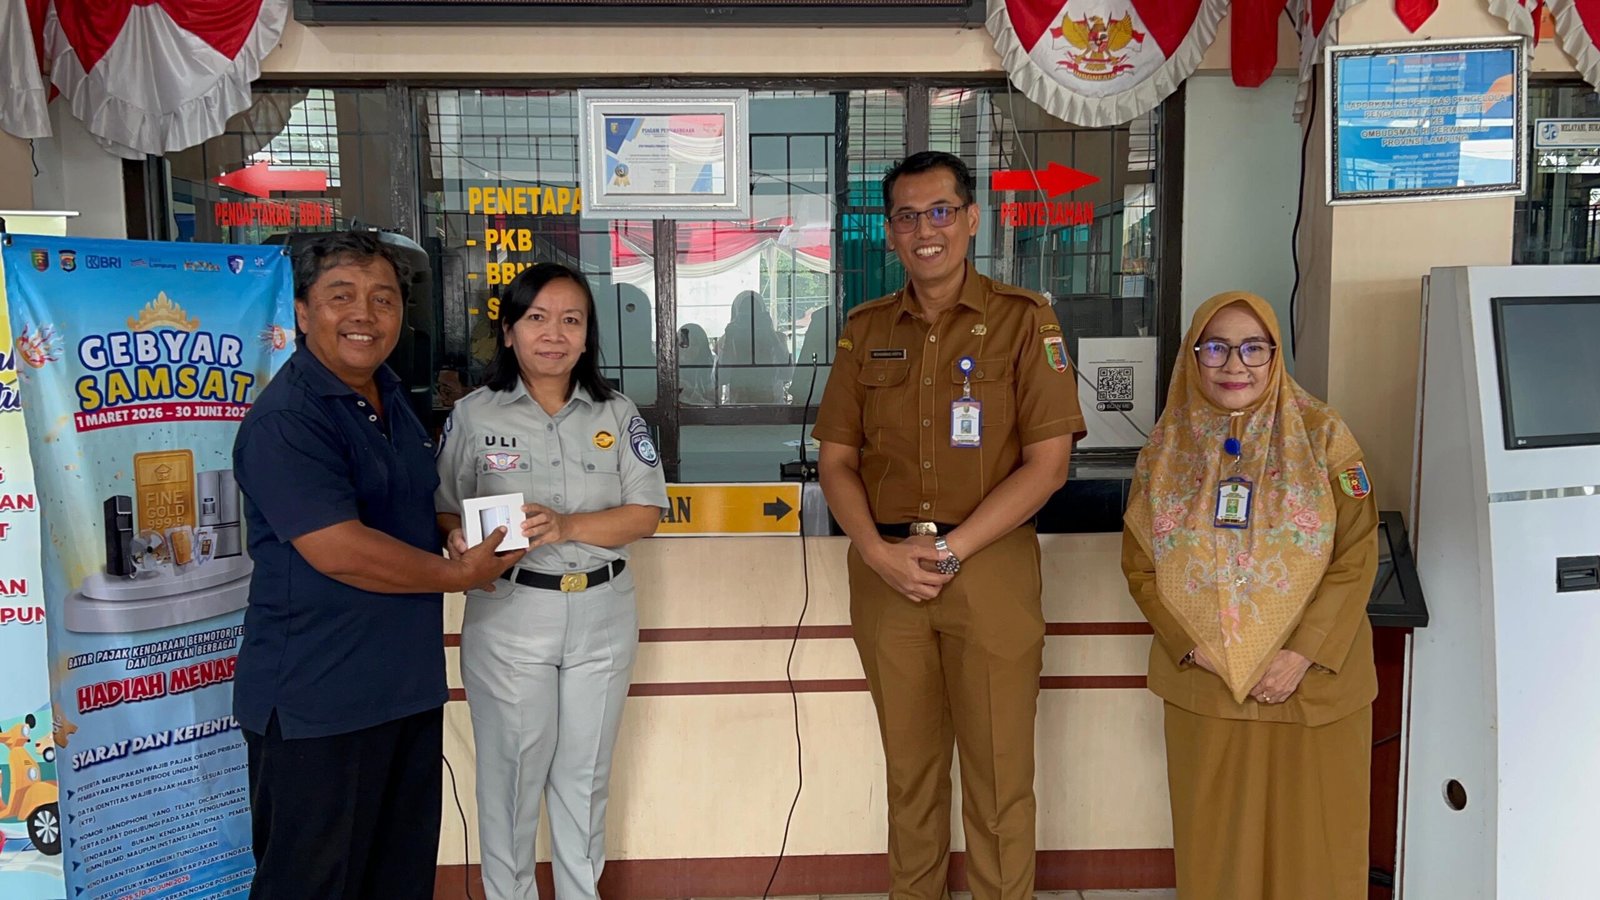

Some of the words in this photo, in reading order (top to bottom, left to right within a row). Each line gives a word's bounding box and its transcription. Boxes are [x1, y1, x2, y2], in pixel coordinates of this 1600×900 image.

[1361, 127, 1418, 139] OMBUDSMAN
[1382, 137, 1423, 148] PROVINSI
[215, 202, 292, 227] PENDAFTARAN
[300, 202, 322, 227] BBN
[1000, 201, 1095, 227] PENYERAHAN
[485, 228, 533, 252] PKB
[100, 256, 122, 269] BRI
[78, 330, 243, 371] GEBYAR
[75, 364, 255, 413] SAMSAT
[76, 416, 84, 428] 1
[86, 410, 129, 427] MARET
[131, 406, 164, 421] 2026
[175, 406, 192, 418] 30
[193, 405, 223, 418] JUNI
[485, 435, 516, 448] ULI
[146, 490, 185, 506] FINE
[147, 504, 185, 519] GOLD
[67, 652, 94, 670] BAYAR
[96, 648, 130, 664] PAJAK
[132, 637, 185, 658] KENDARAAN
[187, 627, 232, 646] BERMOTOR
[126, 658, 148, 671] DAN
[150, 646, 195, 666] DAPATKAN
[196, 638, 238, 656] BERBAGAI
[76, 672, 167, 714] HADIAH
[72, 741, 129, 772] SYARAT
[132, 728, 170, 754] DAN
[77, 780, 100, 793] PESERTA
[101, 767, 144, 784] MERUPAKAN
[146, 761, 169, 772] WAJIB
[170, 756, 193, 767] PAJAK
[194, 749, 217, 760] ORANG
[217, 743, 242, 754] PRIBADI
[77, 784, 120, 803] PEMBAYARAN
[121, 781, 135, 790] PKB
[143, 770, 171, 783] PERIODE
[172, 764, 199, 776] UNDIAN
[77, 806, 95, 818] DATA
[95, 796, 129, 811] IDENTITAS
[130, 788, 153, 800] WAJIB
[153, 782, 176, 794] PAJAK
[177, 776, 201, 787] HARUS
[201, 769, 223, 781] SESUAI
[79, 828, 104, 841] NOMOR
[106, 814, 148, 832] HANDPHONE
[152, 807, 171, 818] YANG
[174, 801, 195, 811] TELAH
[198, 786, 246, 805] DICANTUMKAN
[80, 840, 100, 852] SERTA
[100, 832, 122, 845] DAPAT
[123, 821, 161, 837] DIHUBUNGI
[161, 815, 180, 826] PADA
[180, 809, 199, 819] SAAT
[199, 796, 246, 814] PENGUMUMAN
[126, 845, 157, 858] MAUPUN
[157, 835, 188, 849] INSTANSI
[188, 826, 218, 840] LAINNYA
[131, 835, 155, 847] BUKAN
[158, 820, 200, 838] KENDARAAN
[203, 814, 225, 825] DINAS
[124, 864, 146, 875] TIDAK
[176, 840, 219, 857] TUNGGAKAN
[114, 883, 138, 895] UNTUK
[138, 876, 158, 886] YANG
[158, 863, 198, 879] MEMBAYAR
[197, 856, 220, 867] PAJAK
[158, 881, 173, 891] JUNI
[188, 880, 214, 892] NOMOR
